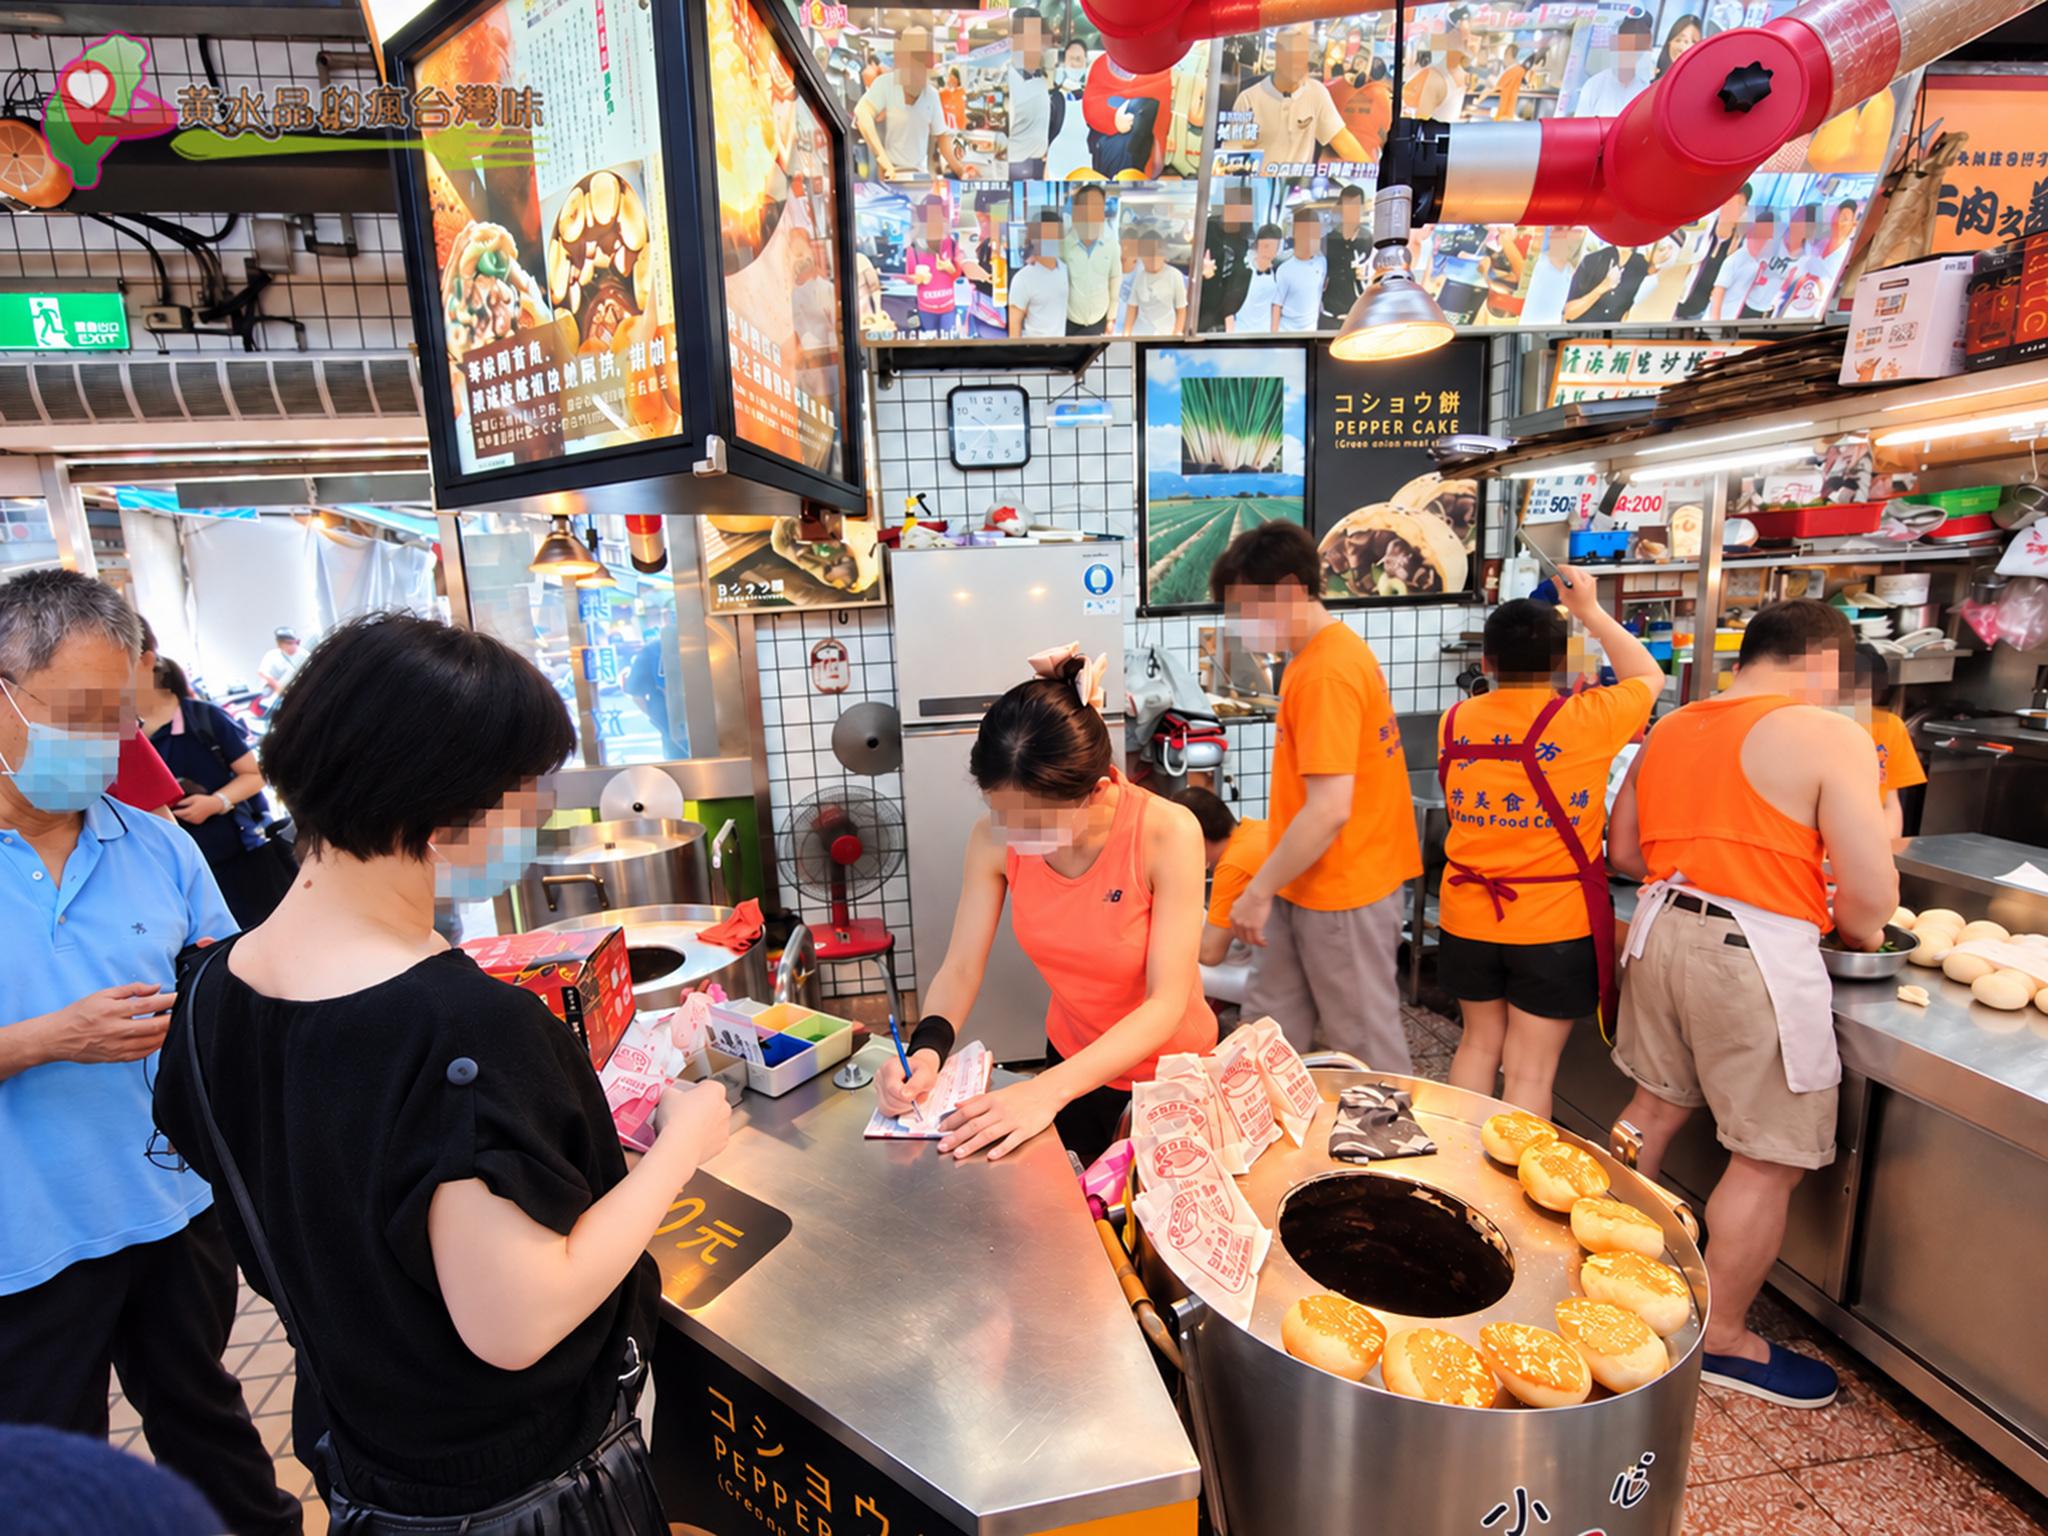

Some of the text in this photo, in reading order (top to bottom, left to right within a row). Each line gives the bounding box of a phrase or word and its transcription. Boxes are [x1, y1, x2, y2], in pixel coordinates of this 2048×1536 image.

[78, 333, 119, 345] EXIT
[1334, 390, 1460, 415] コショウ餅
[1334, 419, 1460, 436] PEPPER CAKE
[1489, 814, 1529, 828] Food
